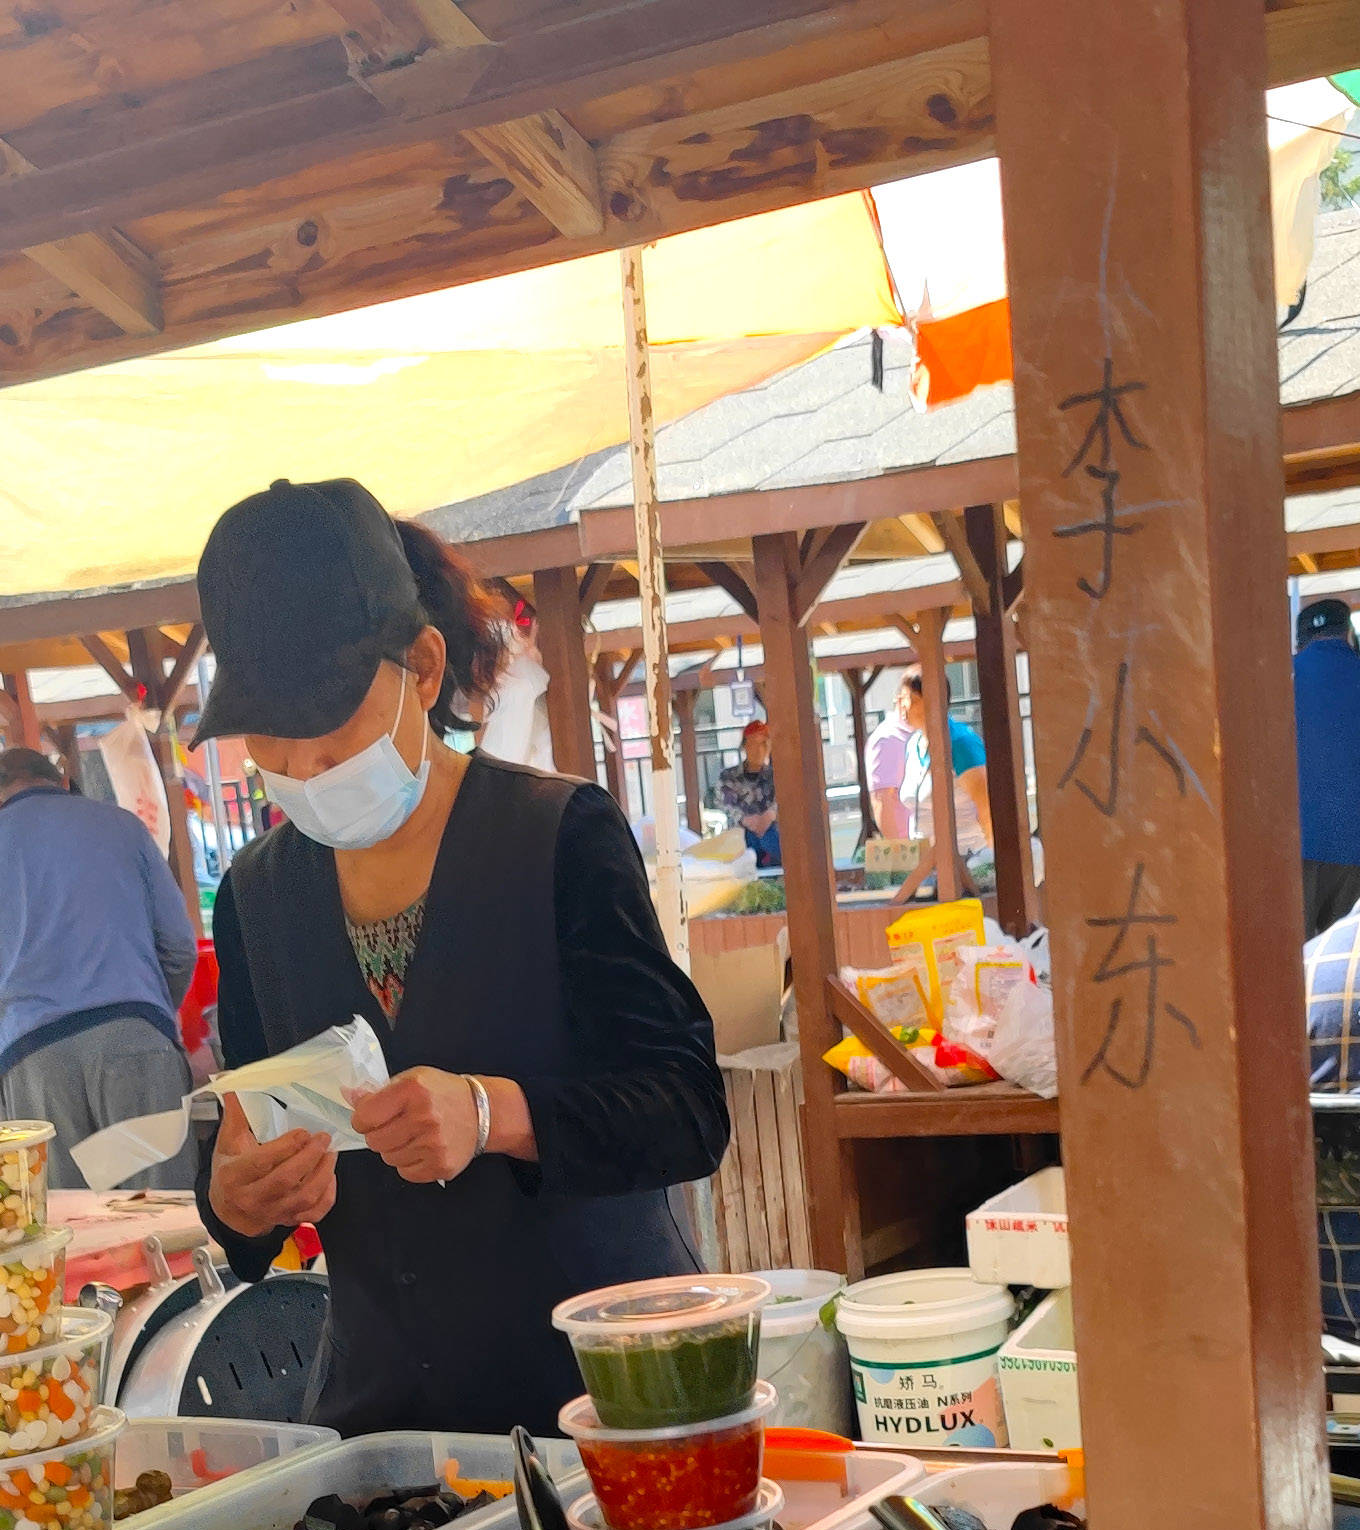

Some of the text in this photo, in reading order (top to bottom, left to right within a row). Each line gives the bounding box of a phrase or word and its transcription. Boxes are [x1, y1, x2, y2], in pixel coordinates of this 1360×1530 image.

[1052, 357, 1201, 1090] 李小东
[937, 1391, 973, 1408] N系列
[874, 1409, 976, 1434] HYDLUX
